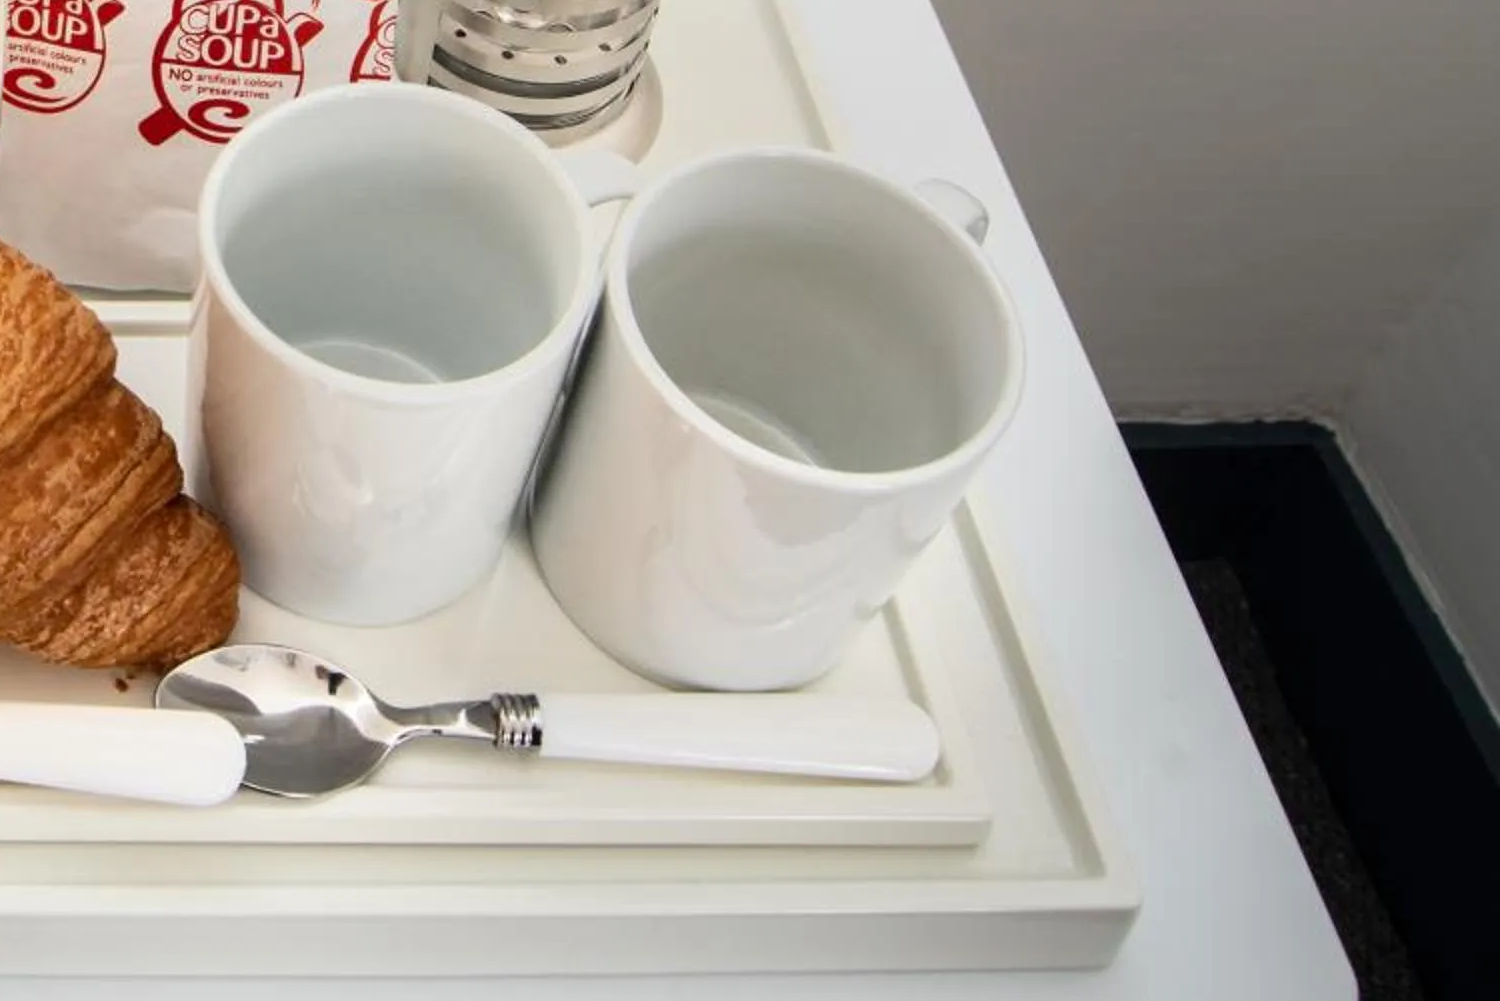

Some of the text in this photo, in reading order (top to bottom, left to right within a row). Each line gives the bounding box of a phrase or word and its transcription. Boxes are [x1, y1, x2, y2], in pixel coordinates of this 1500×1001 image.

[7, 5, 88, 45] OUP
[176, 34, 285, 70] SOUP
[169, 67, 283, 89] NO artificial colours
[197, 85, 269, 100] preservatives
